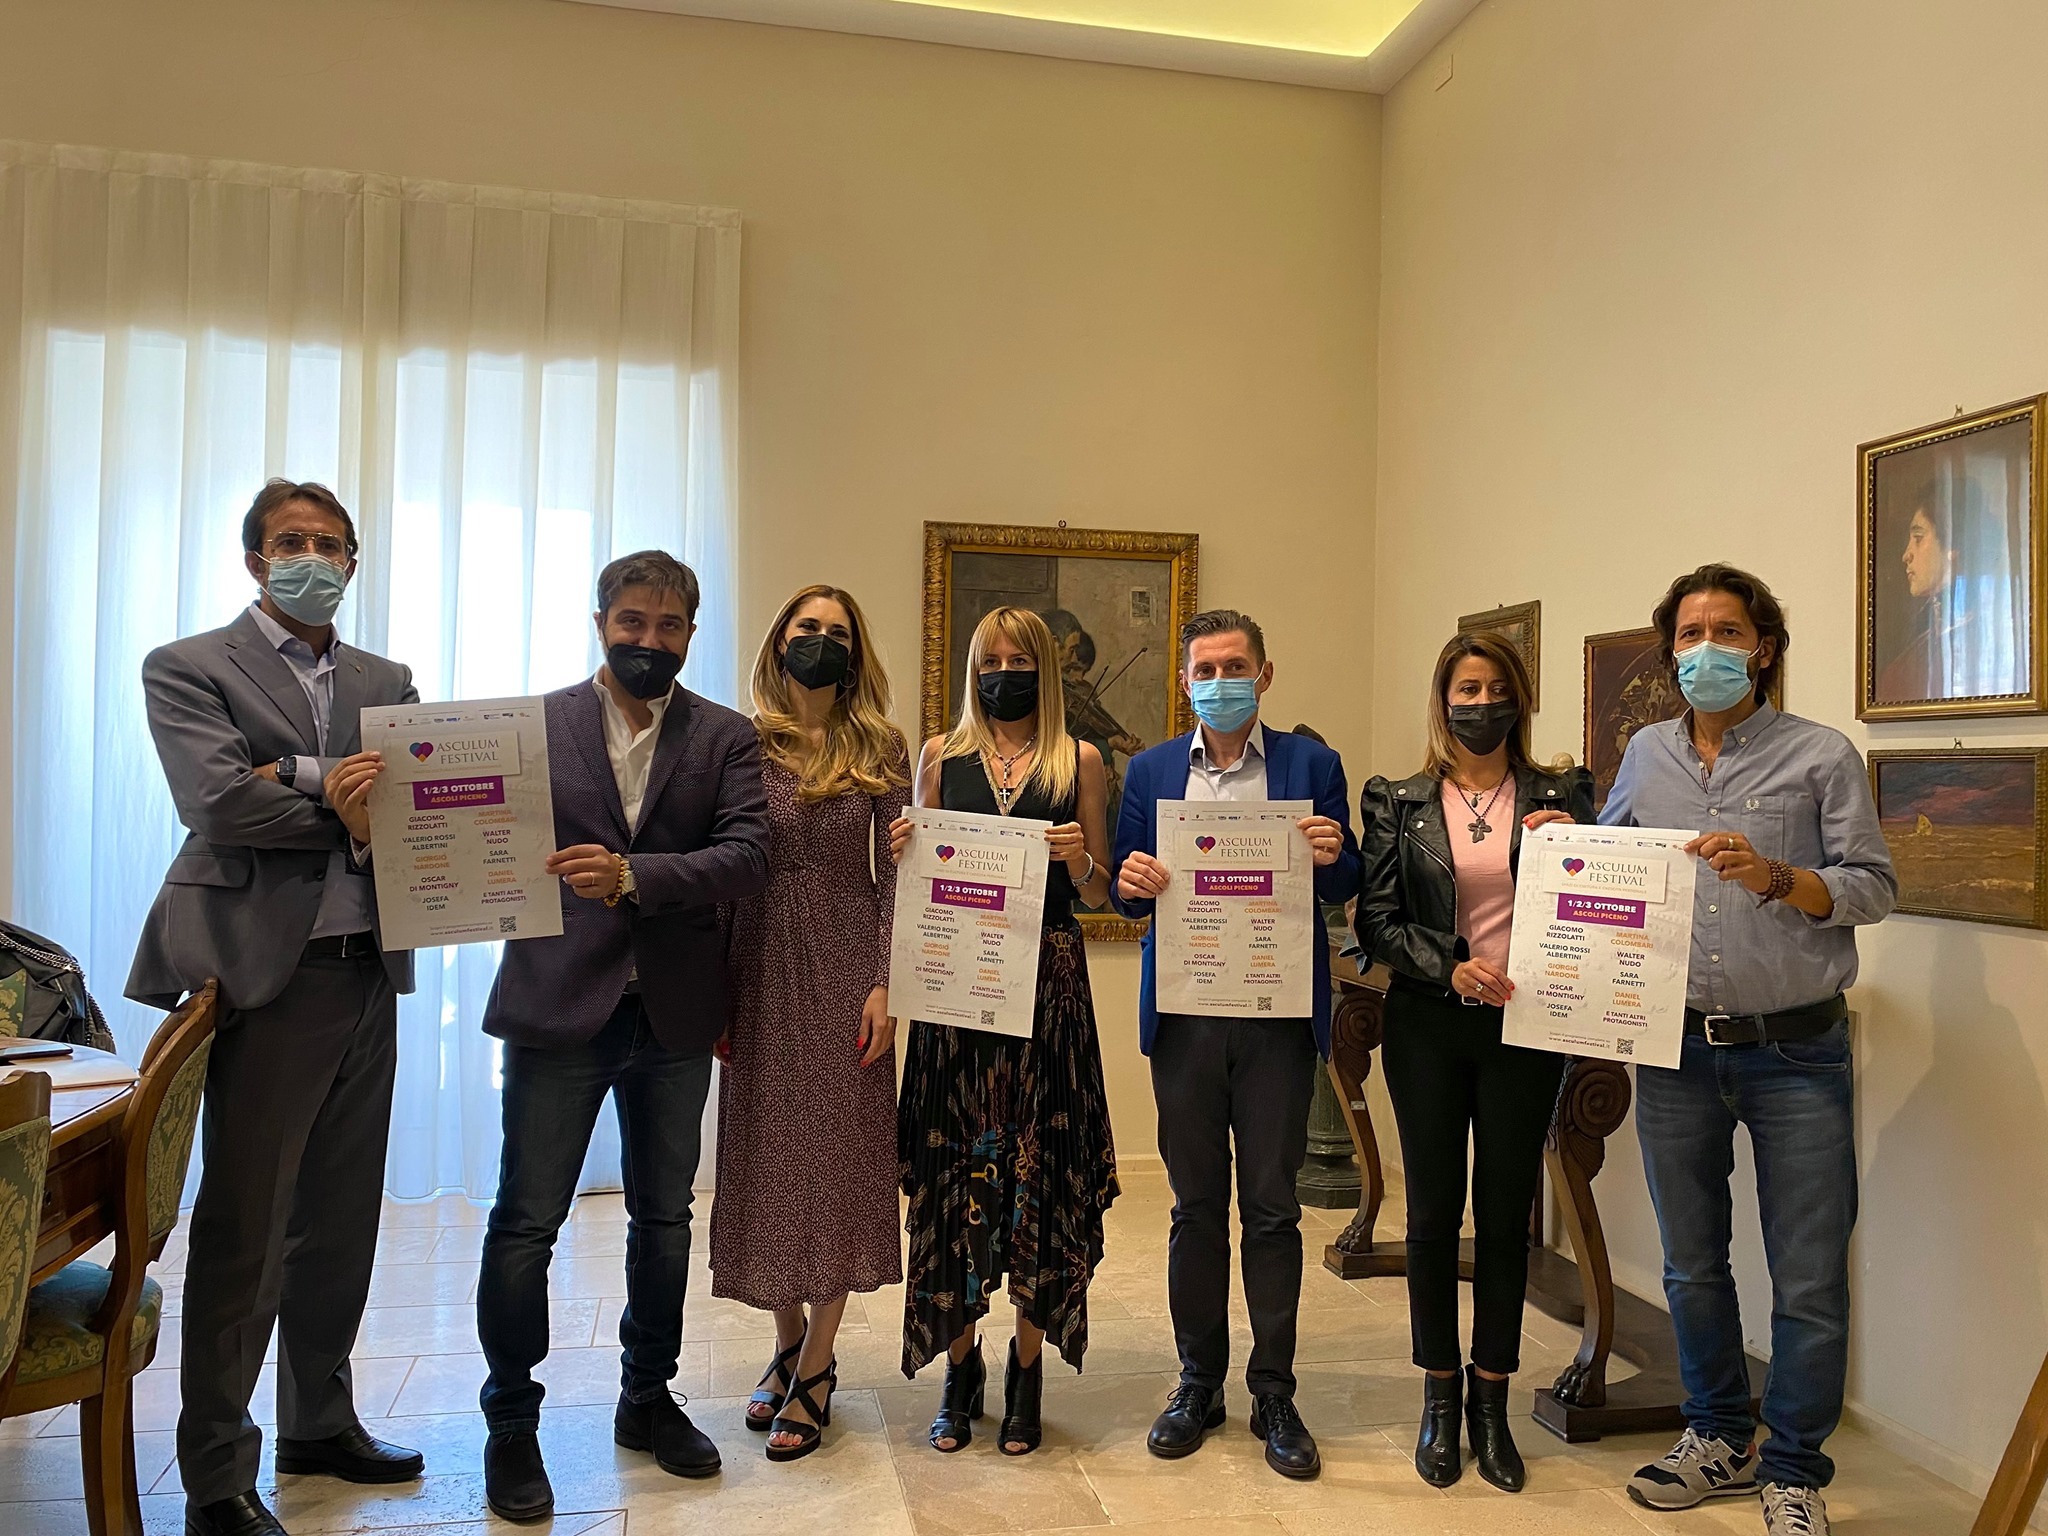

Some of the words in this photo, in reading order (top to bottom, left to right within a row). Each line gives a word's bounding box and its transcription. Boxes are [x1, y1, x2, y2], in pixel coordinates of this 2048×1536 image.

[436, 738, 498, 752] ASCULUM
[440, 751, 498, 764] FESTIVAL
[422, 786, 449, 794] 1/2/3
[450, 782, 494, 792] OTTOBRE
[430, 794, 458, 803] ASCOLI
[459, 792, 487, 800] PICENO
[408, 814, 444, 822] GIACOMO
[473, 816, 516, 825] COLOMBARI
[407, 822, 447, 830] RIZZOLATTI
[402, 835, 433, 843] VALERIO
[1218, 837, 1272, 845] ASCULUM
[411, 842, 447, 850] ALBERTINI
[957, 848, 1008, 861] ASCULUM
[1220, 848, 1270, 857] FESTIVAL
[415, 854, 446, 862] GIORGIO
[483, 856, 516, 864] FARNETTI
[414, 862, 449, 870] NARDONE
[958, 859, 1005, 872] FESTIVAL
[1587, 860, 1648, 874] ASCULUM
[487, 877, 516, 885] LUMERA
[1588, 872, 1645, 886] FESTIVAL
[418, 882, 458, 891] MONTIGNY
[939, 884, 960, 893] 1/2/3
[962, 887, 997, 897] OTTOBRE
[481, 895, 526, 904] PROTAGONISTI
[944, 893, 966, 901] ASCOLI
[967, 896, 990, 904] PICENO
[1566, 899, 1592, 908] 1/2/3
[1593, 902, 1636, 913] OTTOBRE
[925, 907, 953, 915] GIACOMO
[1572, 909, 1599, 918] ASCOLI
[1600, 912, 1627, 921] PICENO
[923, 914, 954, 922] RIZZOLATTI
[975, 920, 1011, 929] COLOMBARI
[1549, 924, 1583, 933] GIACOMO
[923, 931, 951, 940] ALBERTINI
[1546, 932, 1584, 941] RIZZOLATTI
[1616, 932, 1648, 940] MARTINA
[924, 942, 948, 950] GIORGIO
[1539, 943, 1568, 951] VALERIO
[1610, 939, 1652, 948] COLOMBARI
[921, 948, 950, 957] NARDONE
[1546, 951, 1580, 960] ALBERTINI
[1616, 951, 1644, 960] WALTER
[976, 956, 1004, 964] FARNETTI
[922, 967, 954, 976] MONTIGNY
[1547, 963, 1578, 971] GIORGIO
[977, 974, 1001, 982] LUMERA
[1545, 970, 1579, 979] NARDONE
[1549, 983, 1573, 991] OSCAR
[1611, 978, 1644, 987] FARNETTI
[969, 991, 1006, 1000] PROTAGONISTI
[1546, 990, 1584, 1000] MONTIGNY
[1614, 991, 1640, 999] DANIEL
[1546, 1003, 1572, 1011] JOSEFA
[1612, 998, 1641, 1007] LUMERA
[1603, 1017, 1648, 1027] PROTAGONISTI
